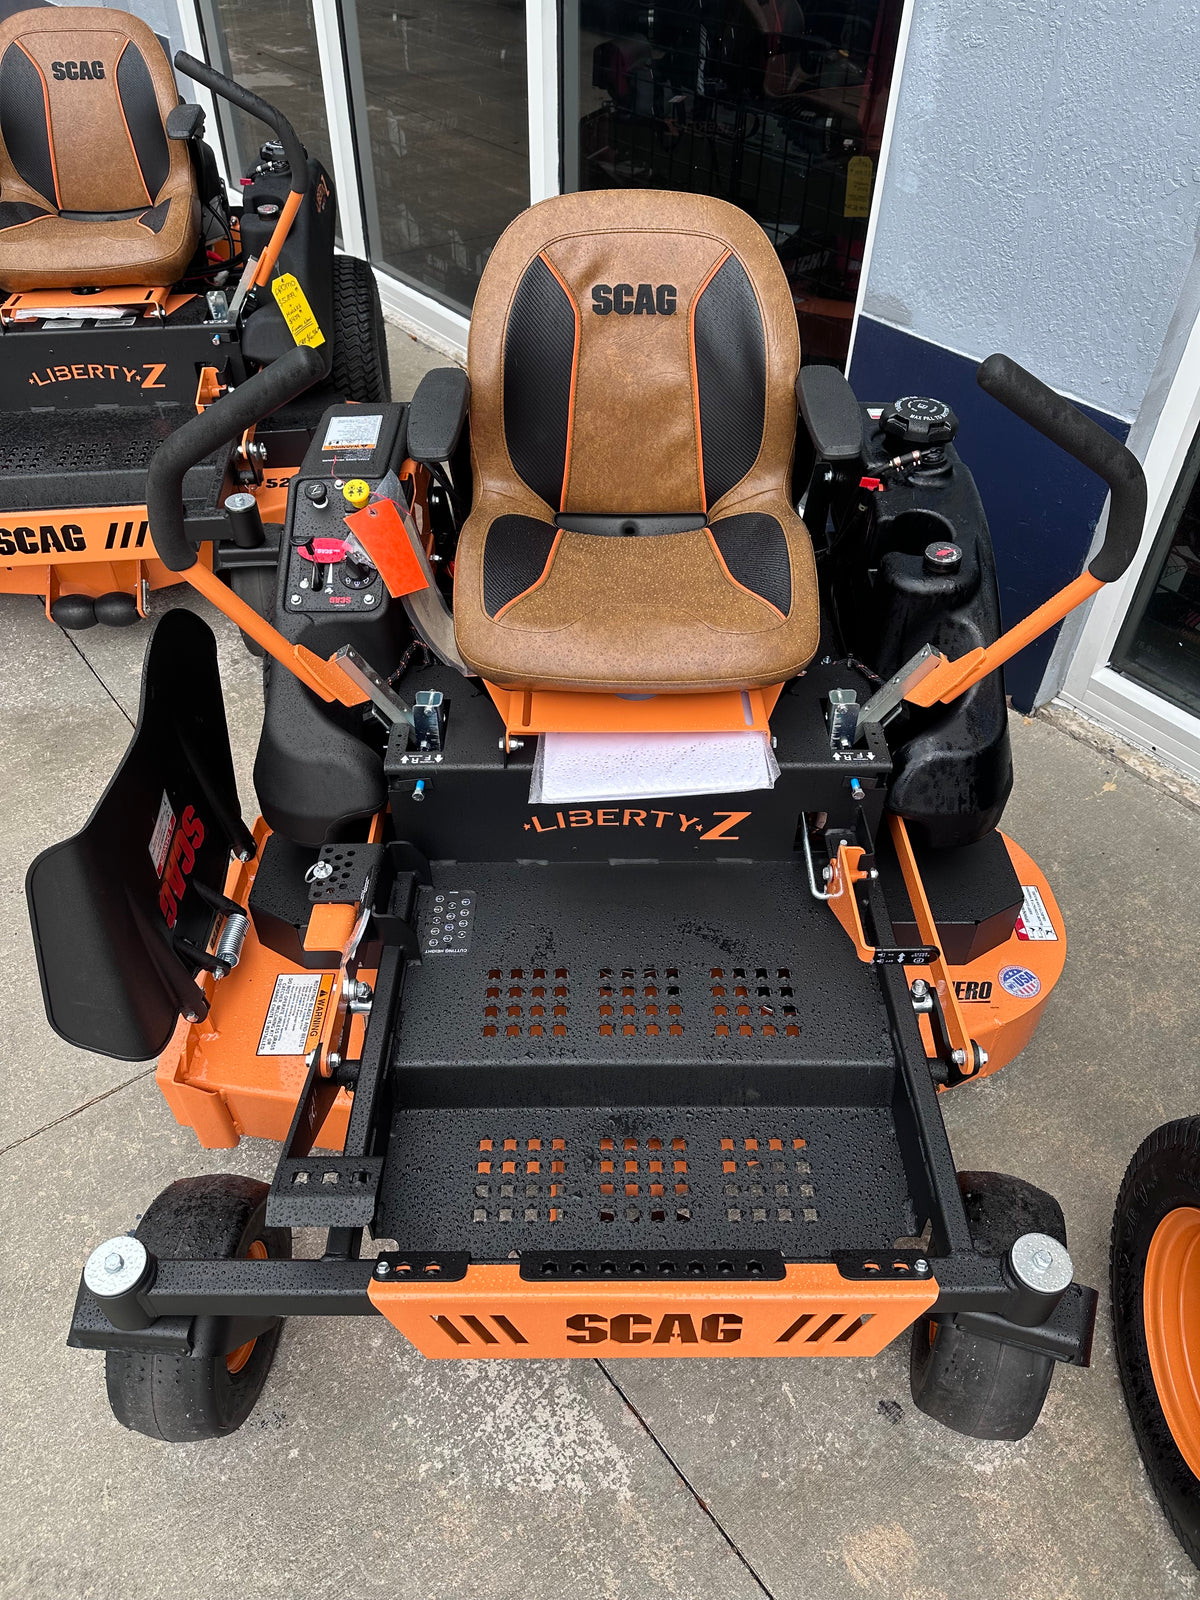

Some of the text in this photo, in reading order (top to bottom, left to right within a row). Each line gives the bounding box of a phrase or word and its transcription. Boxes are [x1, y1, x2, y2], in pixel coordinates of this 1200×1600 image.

[52, 60, 105, 81] SCAG
[591, 283, 677, 315] SCAG
[31, 363, 167, 388] LIBERTY Z
[266, 477, 290, 488] 52
[0, 524, 87, 555] SCAG
[329, 596, 351, 604] SCAG
[531, 808, 752, 840] LIBERTY Z
[160, 805, 204, 929] SCAG
[1012, 971, 1036, 987] USA
[273, 979, 283, 1002] DISCHARGE
[310, 981, 319, 1001] ROTATING
[952, 981, 993, 1000] ERO
[280, 996, 288, 1014] OPERATE
[305, 1004, 313, 1020] BLADES
[271, 1006, 281, 1028] MULCHING
[275, 1017, 283, 1033] UNLESS
[310, 998, 326, 1037] WARNING
[260, 1026, 270, 1049] INSTALLED
[270, 1036, 278, 1050] GRASS
[566, 1314, 743, 1344] SCAG
